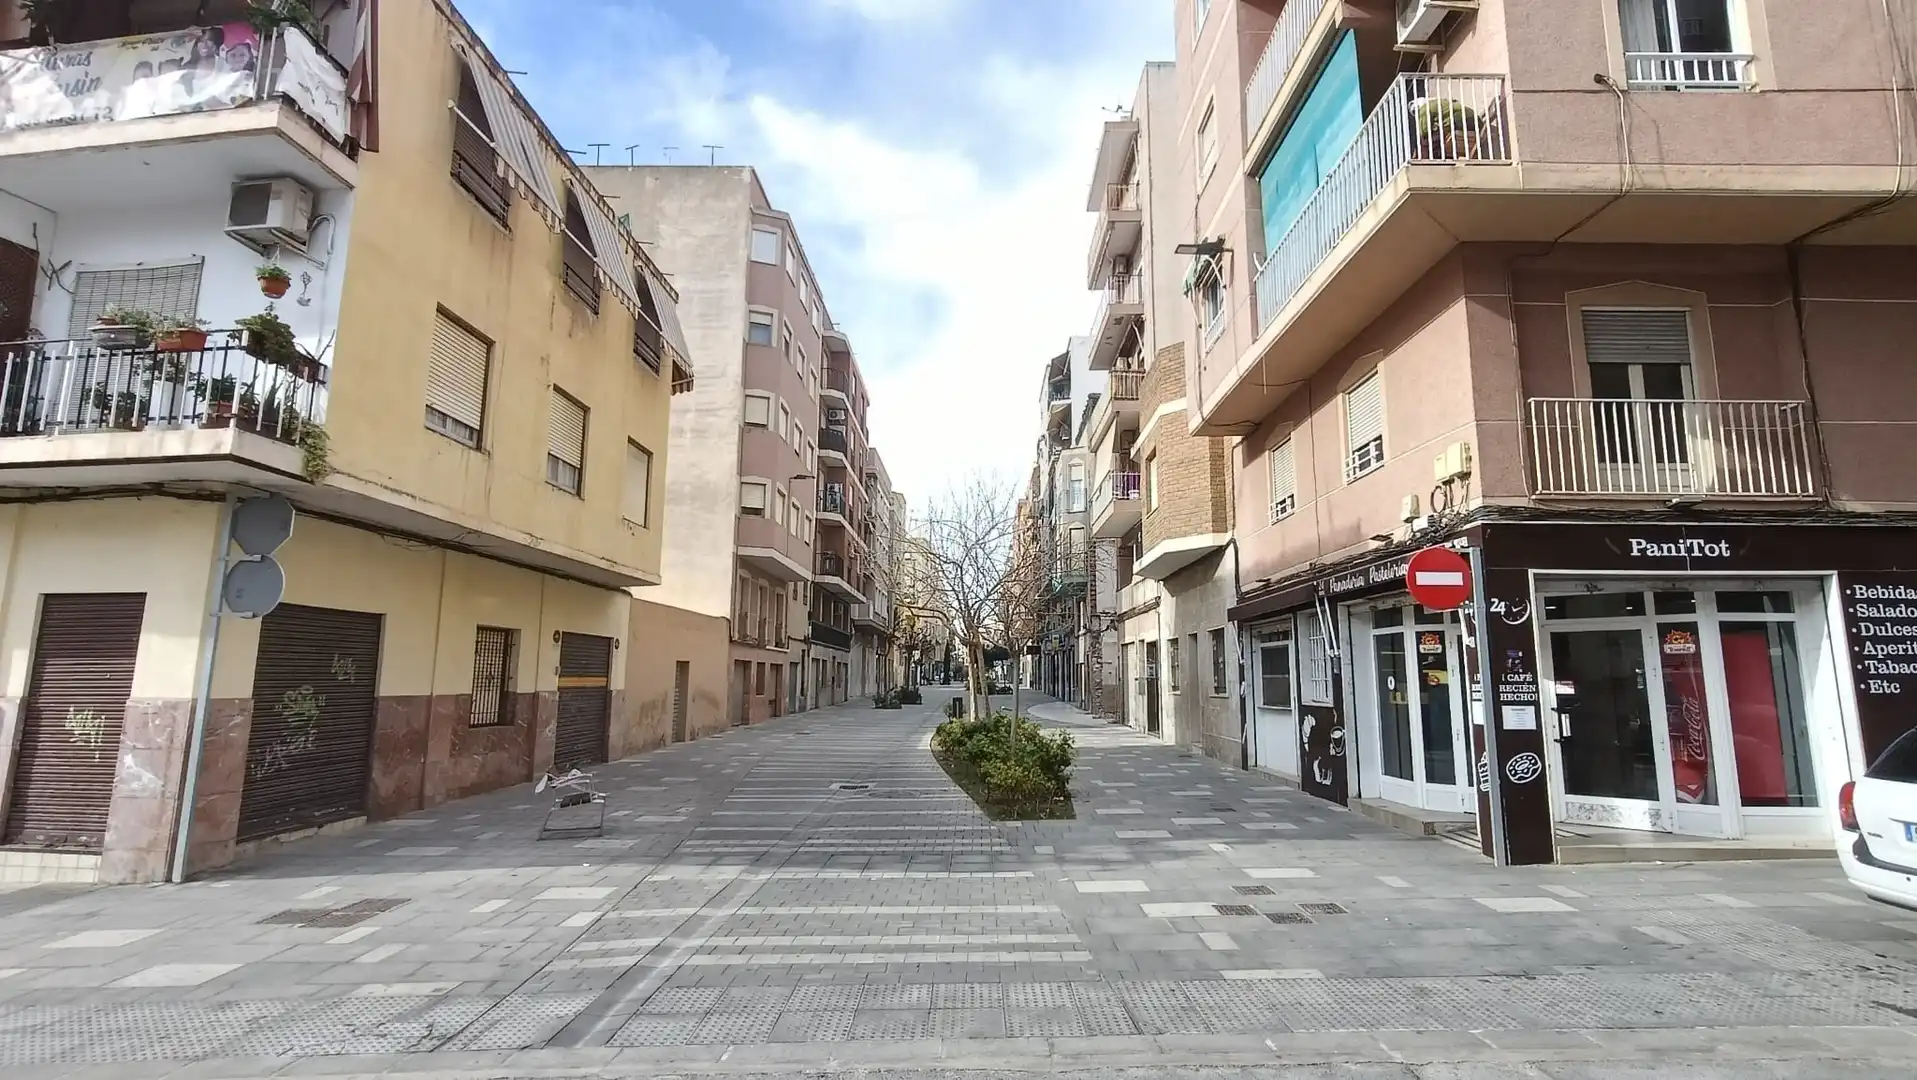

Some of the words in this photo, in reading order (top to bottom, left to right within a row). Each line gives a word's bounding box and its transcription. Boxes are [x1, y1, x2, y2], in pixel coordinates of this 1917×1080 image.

[1628, 538, 1731, 557] PaniTot
[1853, 584, 1917, 600] Bebida
[1489, 597, 1506, 616] 24
[1867, 679, 1901, 694] Etc
